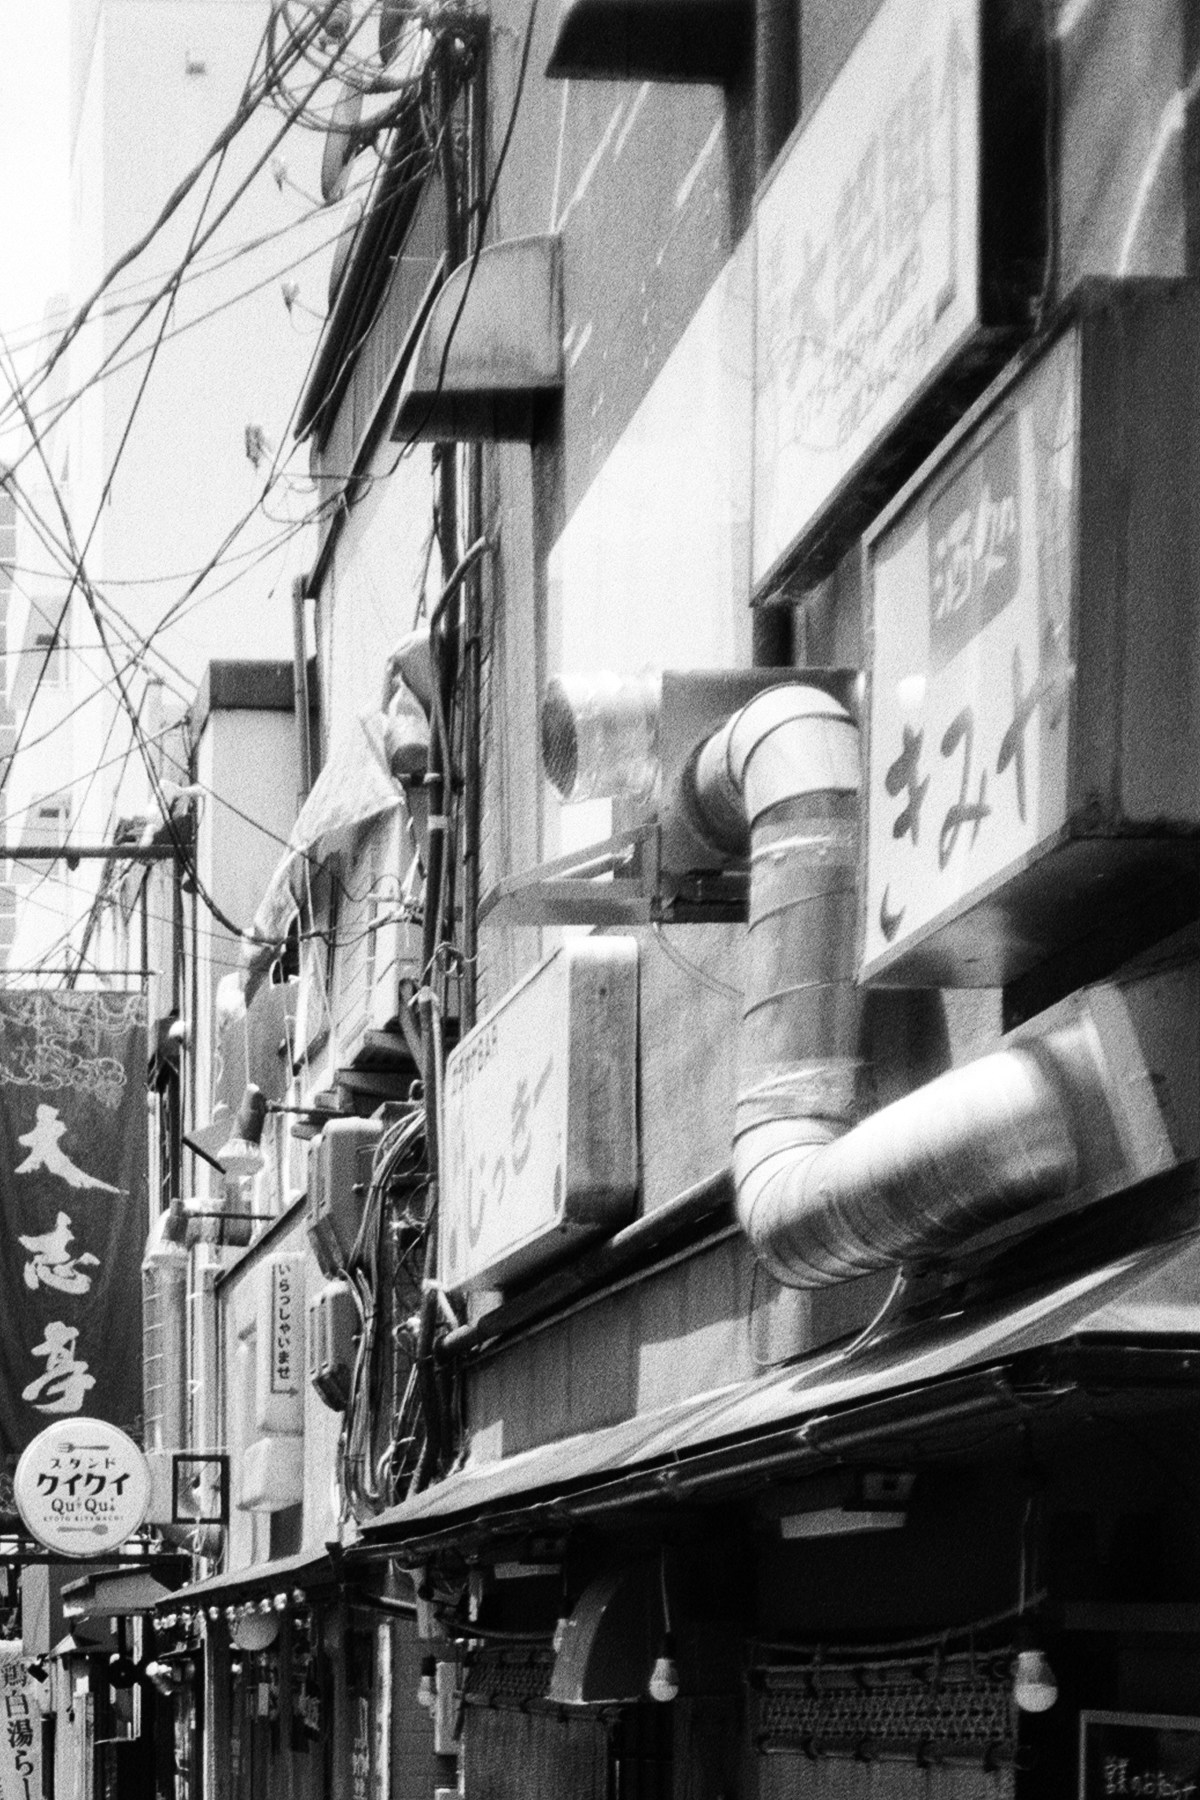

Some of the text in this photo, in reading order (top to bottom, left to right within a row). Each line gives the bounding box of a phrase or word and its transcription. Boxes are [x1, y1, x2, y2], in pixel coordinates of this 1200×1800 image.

[277, 1263, 292, 1380] いらっしゃいませ
[50, 1457, 116, 1470] スタンド
[36, 1472, 131, 1497] クイクイ
